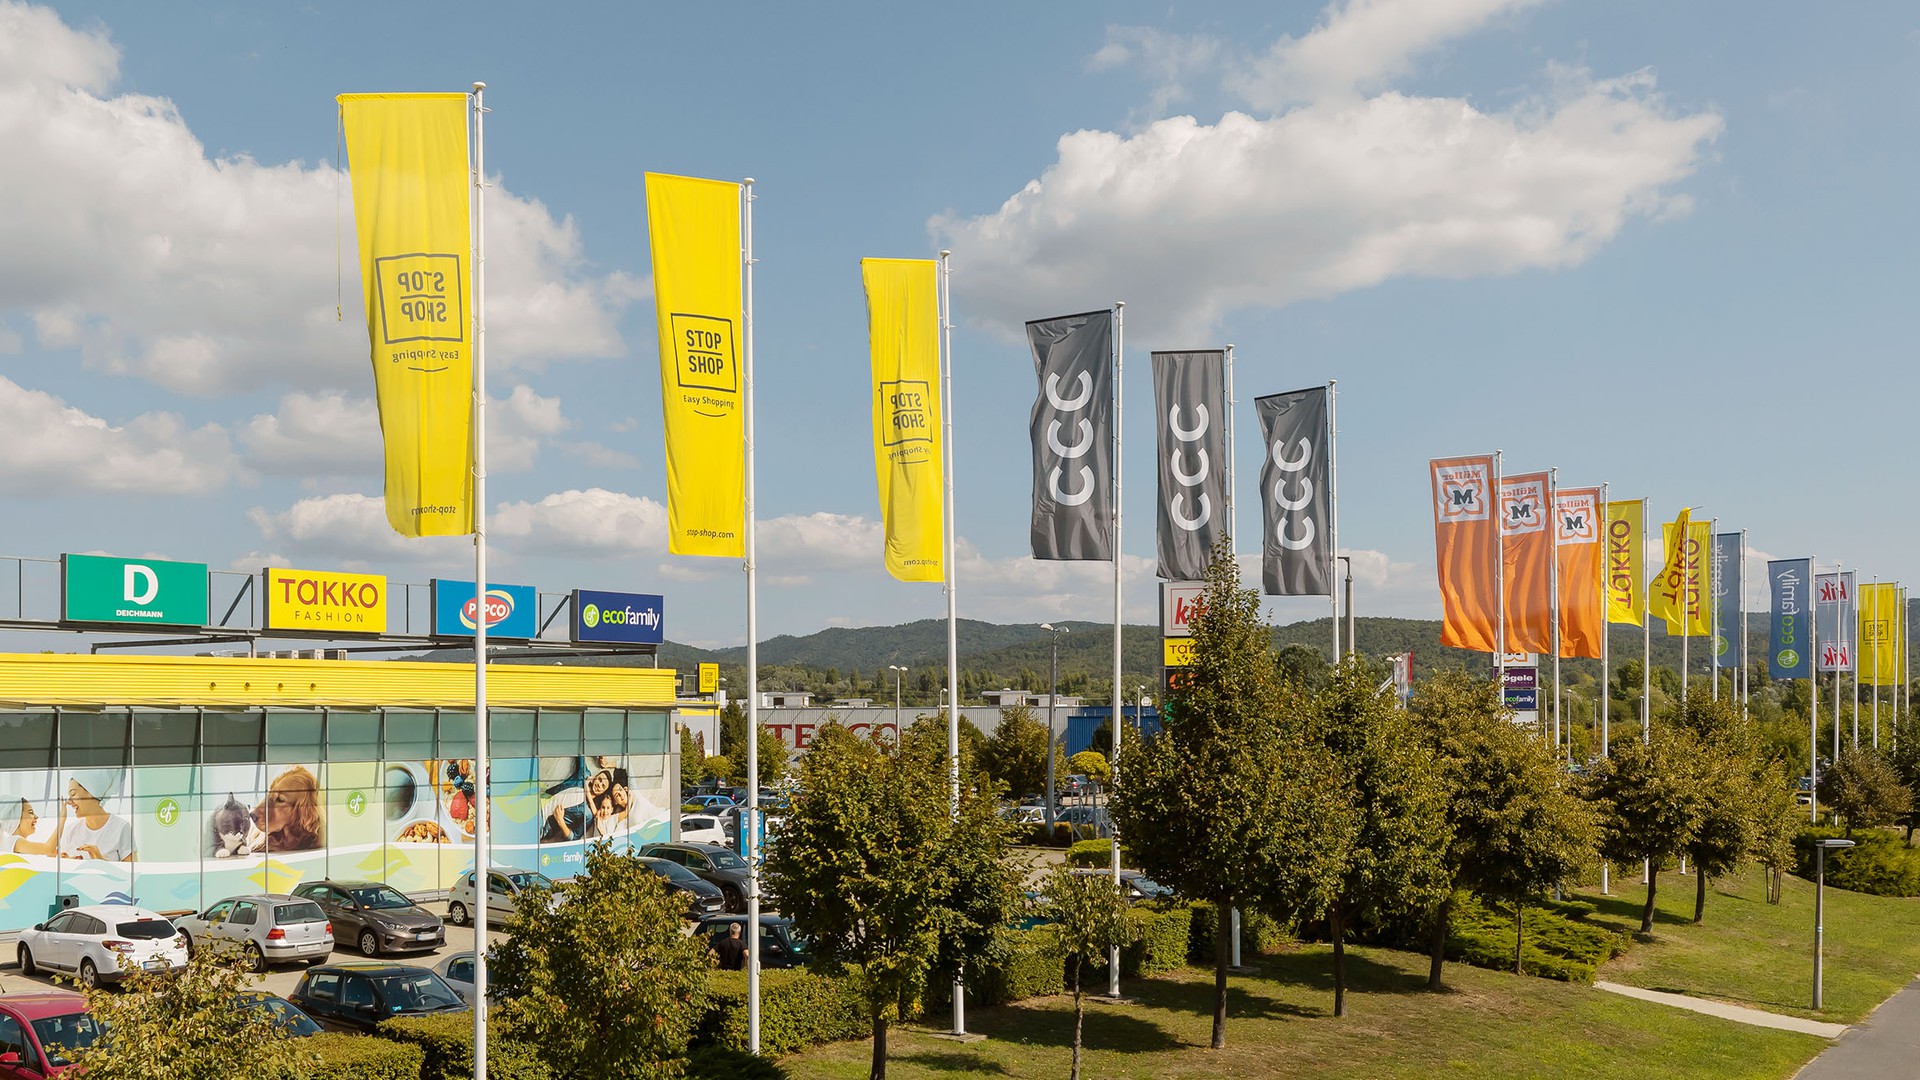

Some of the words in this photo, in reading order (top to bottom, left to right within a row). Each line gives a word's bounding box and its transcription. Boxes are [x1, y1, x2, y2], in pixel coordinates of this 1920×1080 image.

[686, 329, 722, 350] STOP
[688, 355, 724, 375] SHOP
[683, 394, 701, 406] Easy
[702, 396, 735, 410] Shopping
[1045, 369, 1095, 507] CCC
[1169, 402, 1211, 531] CCC
[1272, 436, 1315, 551] CCC
[124, 564, 159, 605] D
[116, 609, 163, 618] DEICHMANN
[295, 610, 364, 622] FASHION
[468, 602, 507, 618] PPCO
[602, 605, 660, 631] ecofamily
